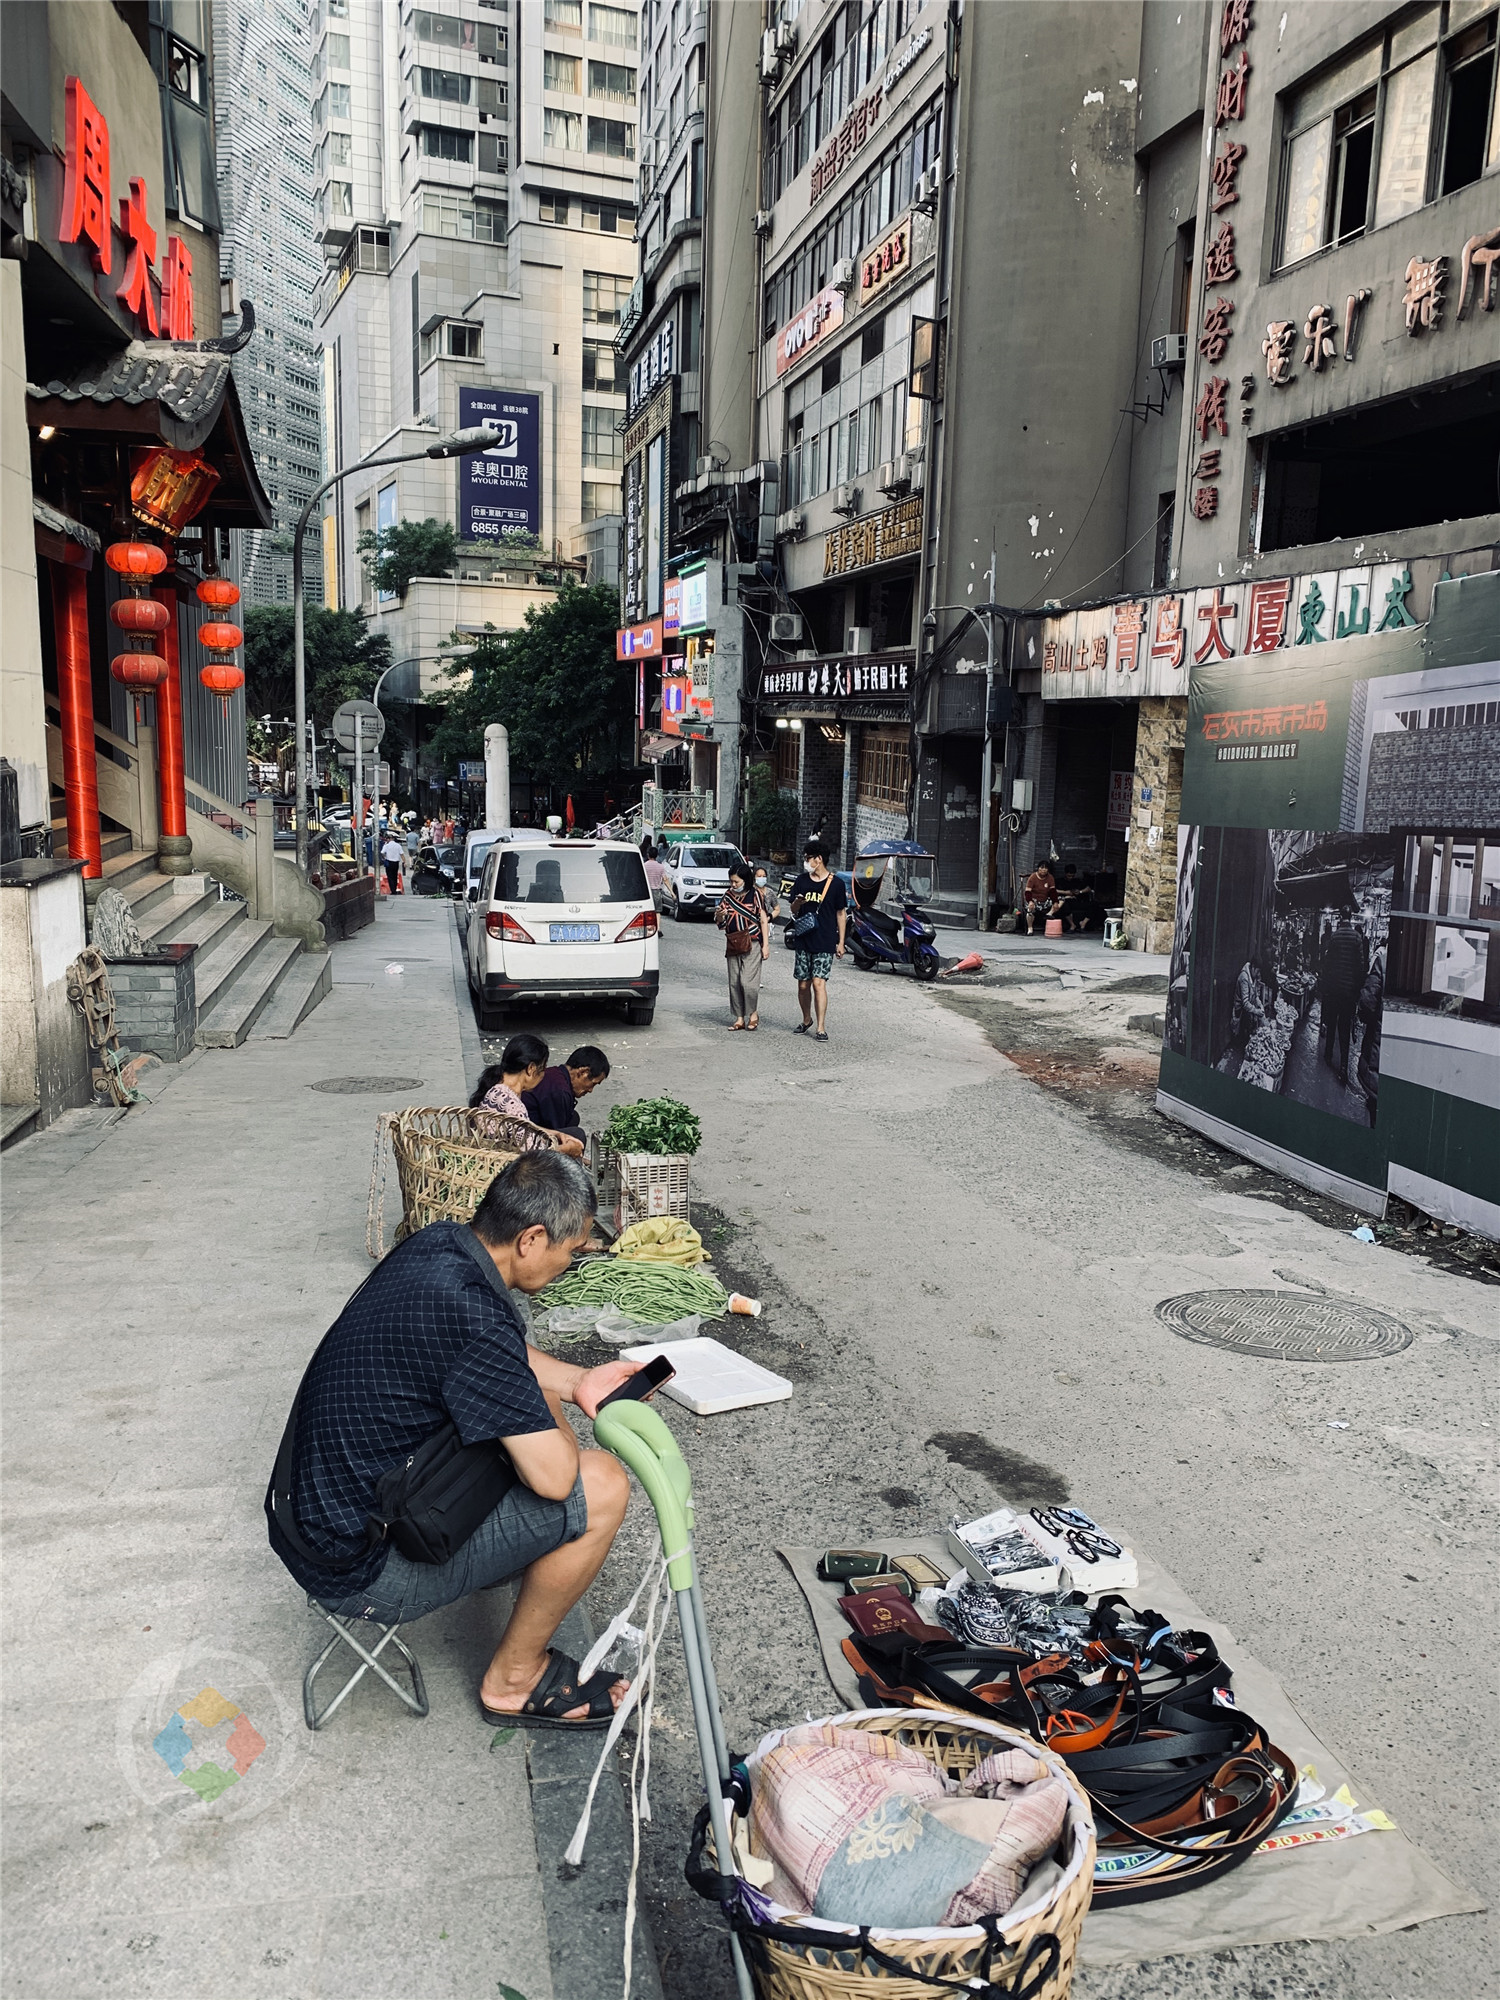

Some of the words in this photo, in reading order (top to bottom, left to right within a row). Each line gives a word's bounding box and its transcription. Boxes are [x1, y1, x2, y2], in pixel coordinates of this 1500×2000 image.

[471, 461, 528, 481] 美奥口腔
[471, 477, 498, 485] MYOUR
[500, 479, 528, 488] DENTAL
[471, 522, 499, 534] 6855
[1113, 577, 1293, 672] 青鸟大厦
[1043, 639, 1108, 674] 高山土鸡
[1260, 743, 1297, 759] MARKET
